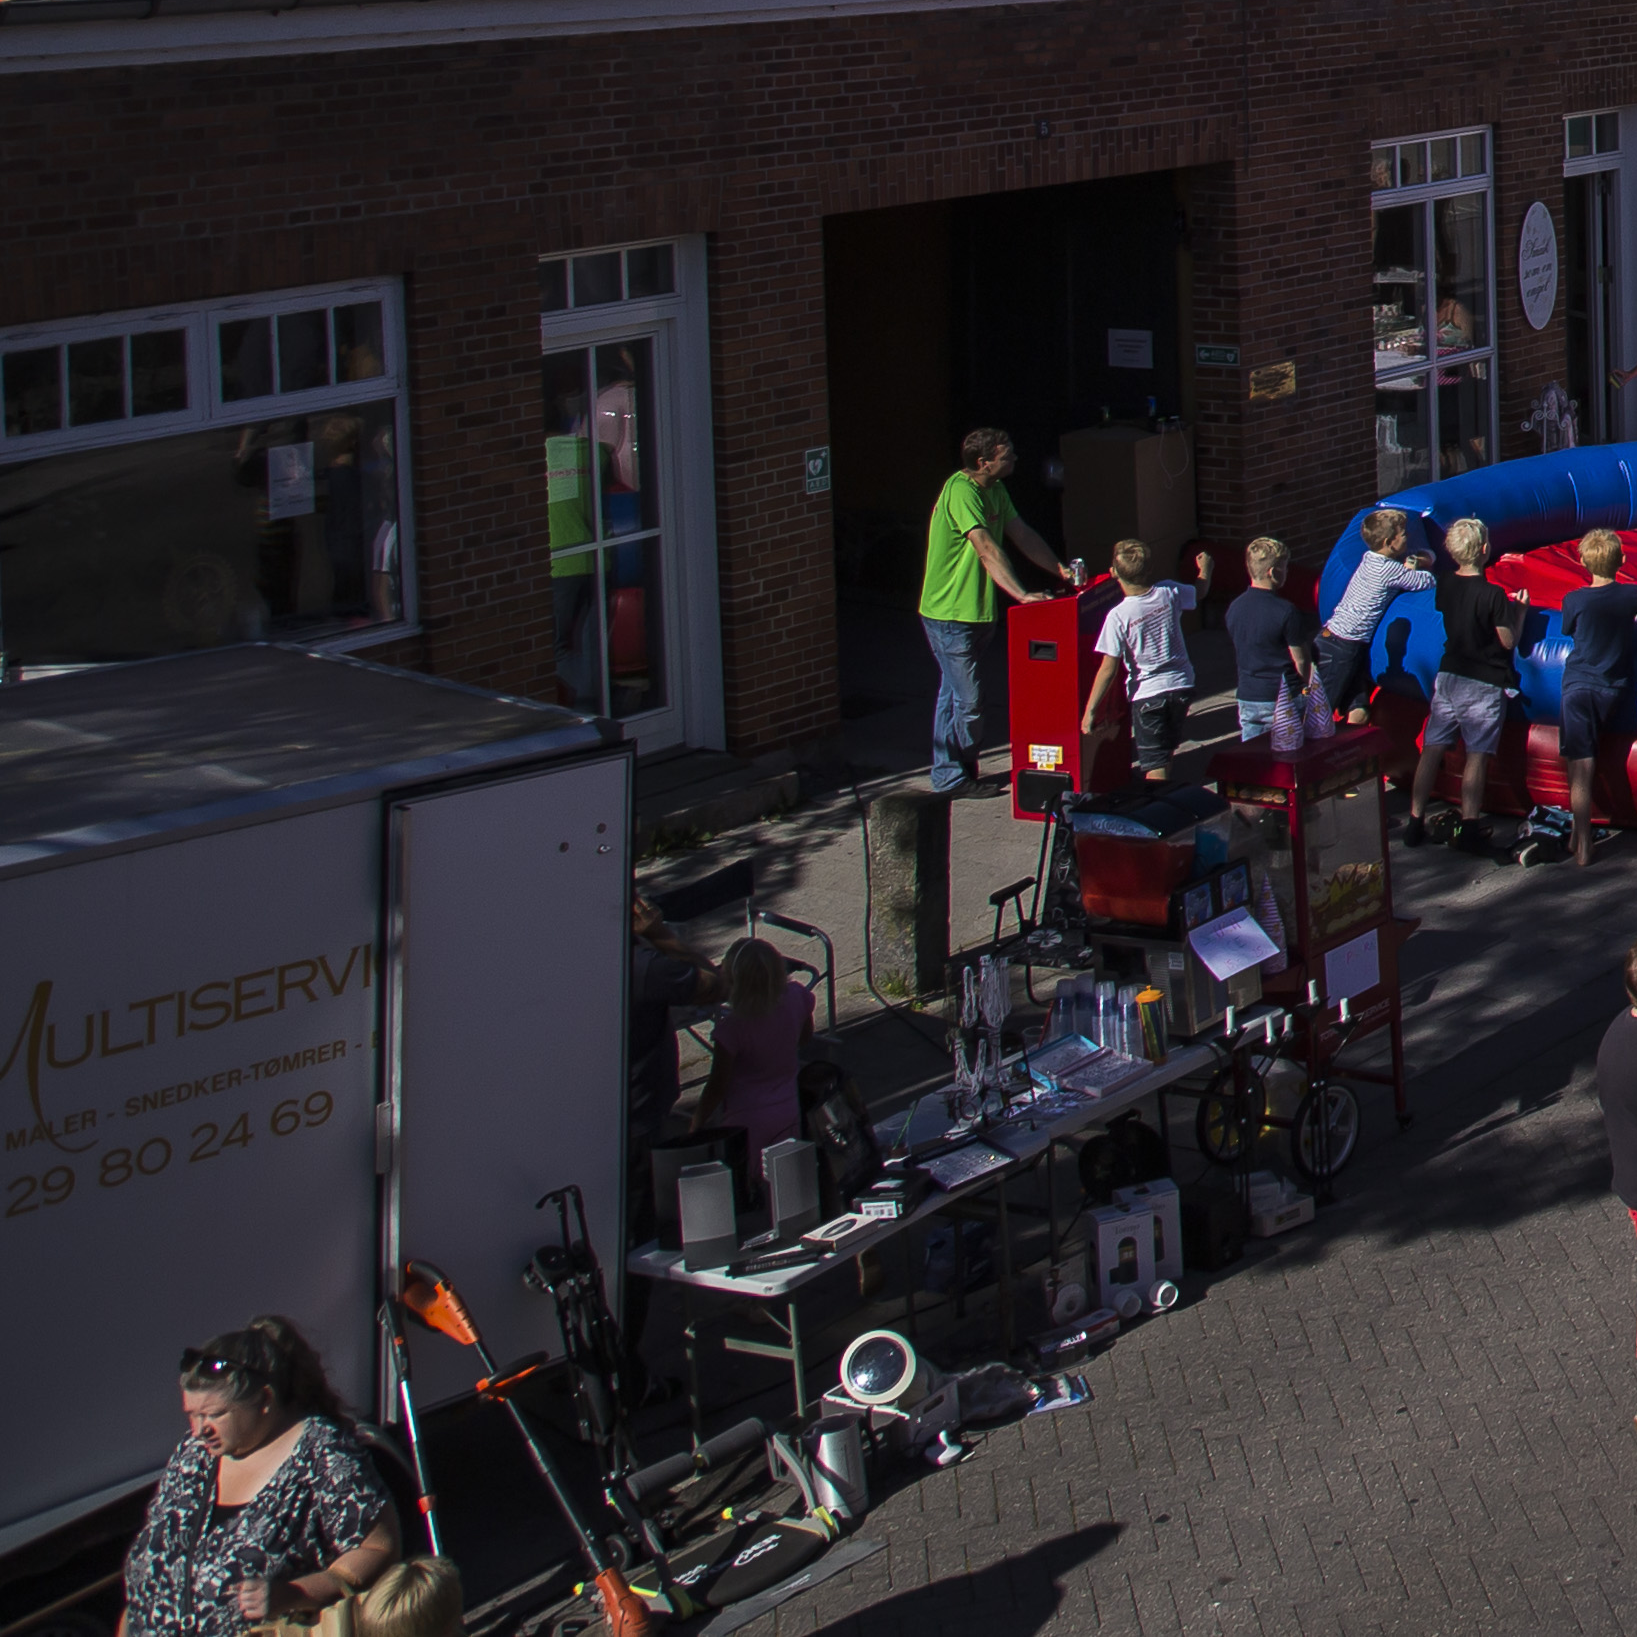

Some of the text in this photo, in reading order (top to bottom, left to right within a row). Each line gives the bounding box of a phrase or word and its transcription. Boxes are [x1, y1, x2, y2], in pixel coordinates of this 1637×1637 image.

[1040, 121, 1049, 136] 5
[5, 1039, 347, 1152] MALER SNEDKER-TØMRER
[4, 1090, 334, 1219] 29 80 24 69
